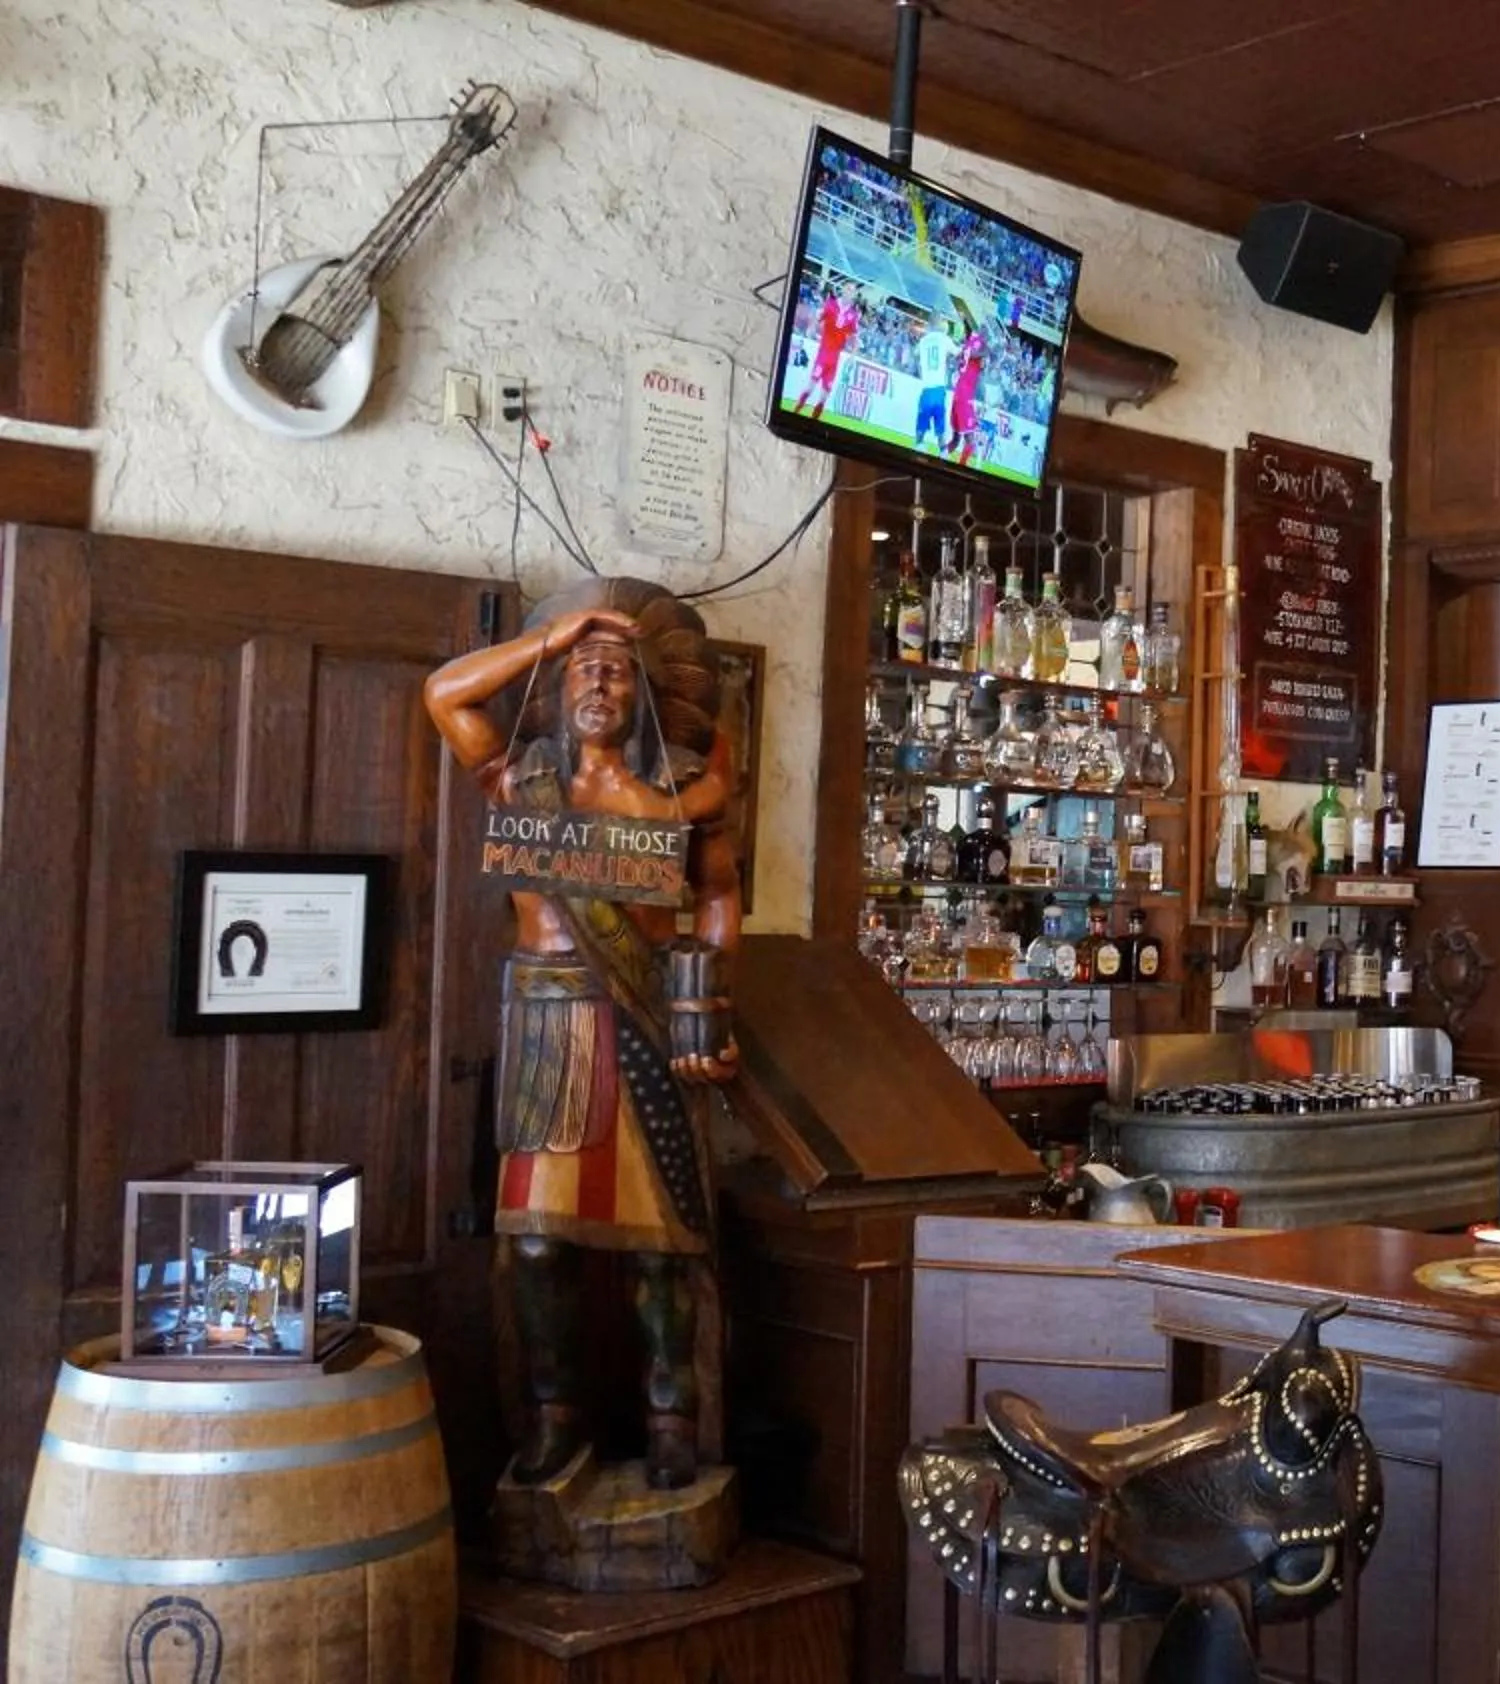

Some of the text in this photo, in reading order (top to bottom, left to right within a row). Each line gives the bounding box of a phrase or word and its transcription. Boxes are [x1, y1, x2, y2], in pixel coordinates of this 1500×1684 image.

[643, 370, 706, 401] NOTICE
[486, 813, 681, 856] LOOK AT THOSE
[481, 841, 685, 893] MACANUDOS
